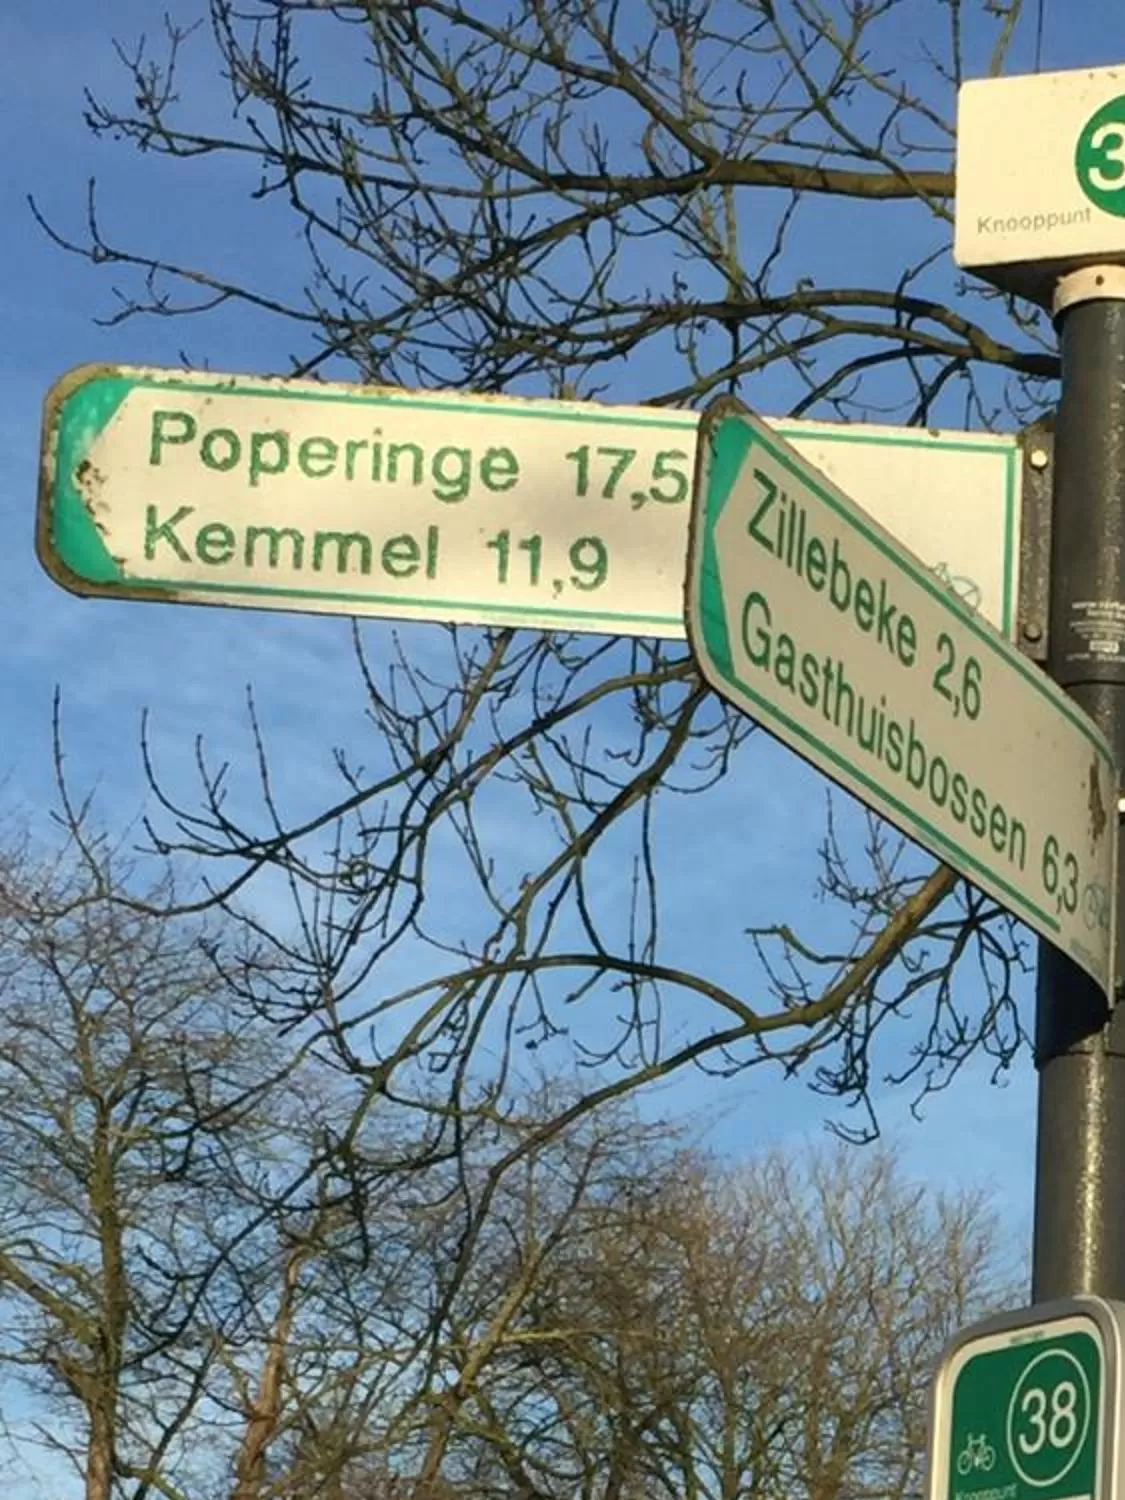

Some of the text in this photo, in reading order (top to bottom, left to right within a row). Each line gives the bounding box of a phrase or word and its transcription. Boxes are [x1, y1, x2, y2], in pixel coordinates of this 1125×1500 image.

[976, 207, 1092, 234] Knooppunt
[148, 409, 690, 511] Poperinge 17,5
[142, 504, 610, 596] Kemmel 11,9
[747, 468, 983, 721] Zillebeke 2,6
[741, 590, 1080, 915] Gasthuisbossen 6,3
[1018, 1381, 1077, 1455] 38
